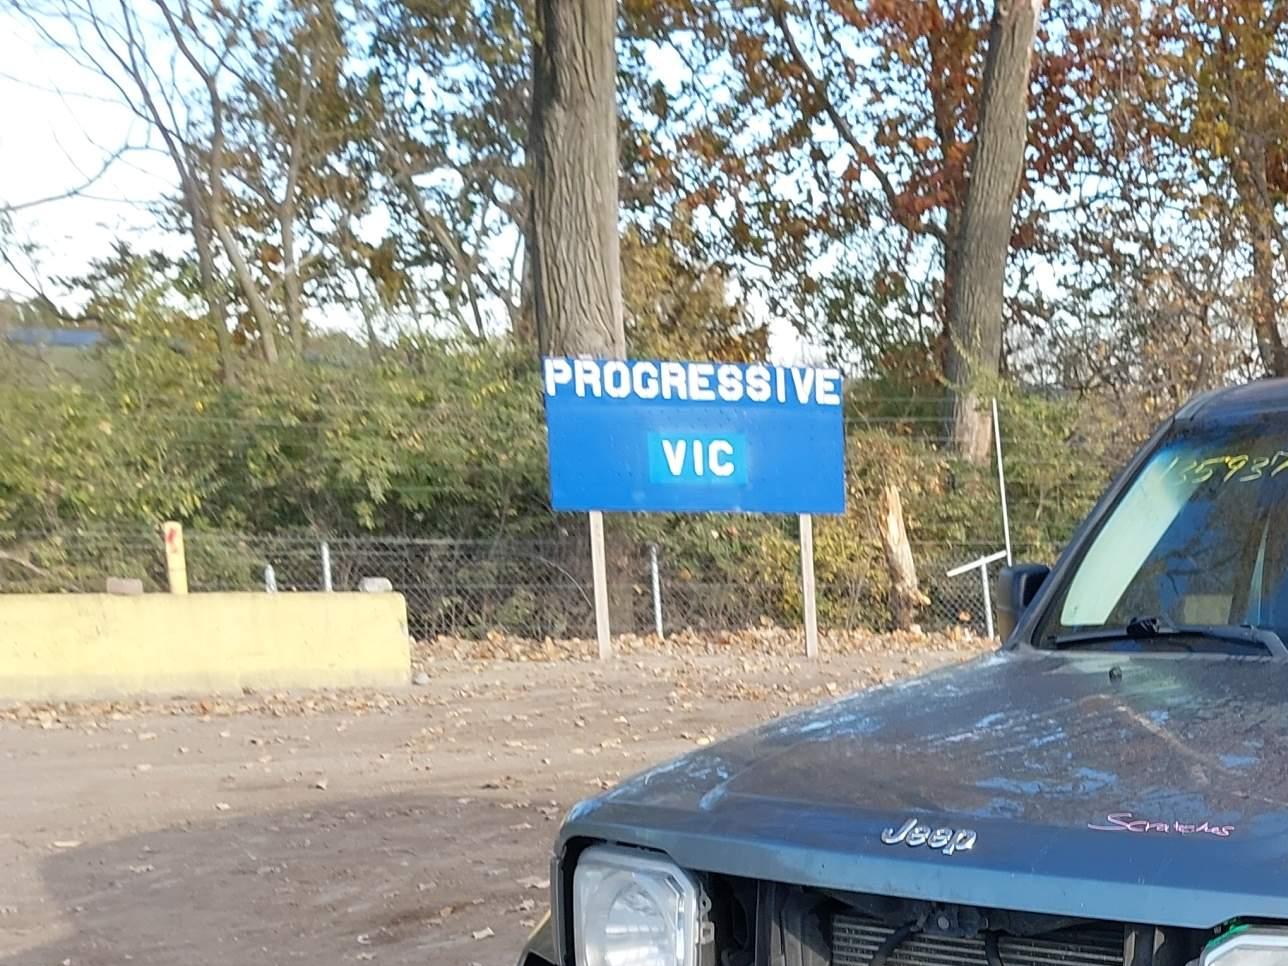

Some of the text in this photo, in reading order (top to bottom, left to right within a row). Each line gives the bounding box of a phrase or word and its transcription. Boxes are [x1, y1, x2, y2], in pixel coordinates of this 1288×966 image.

[544, 358, 841, 405] PROGRESSIVE
[661, 439, 735, 477] VIC
[881, 818, 977, 856] Jeep
